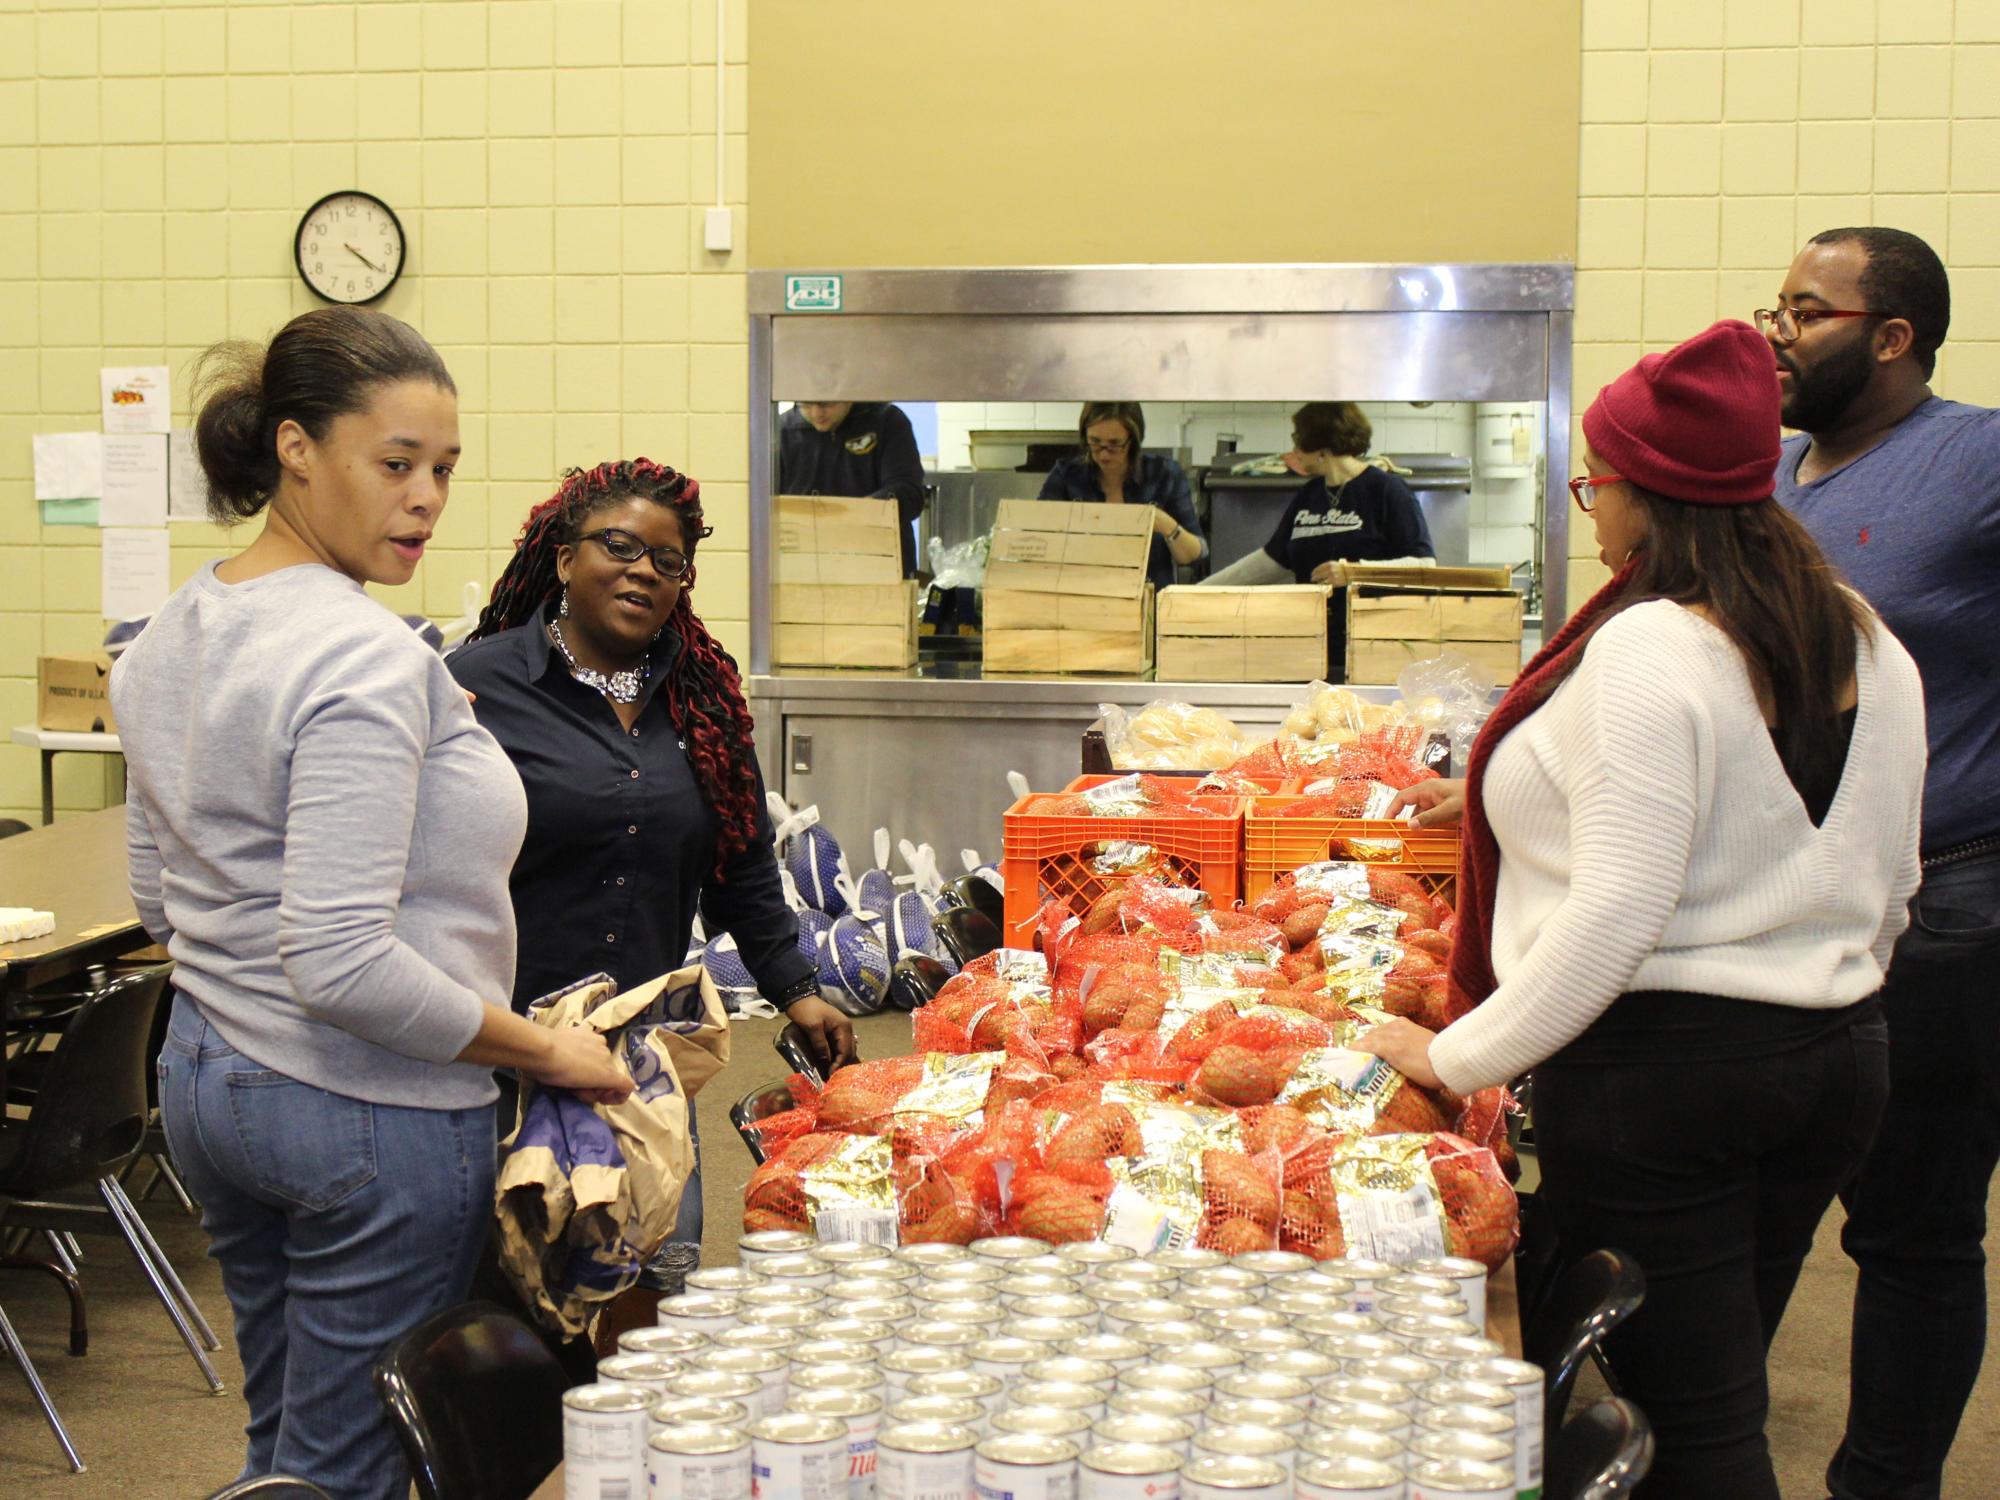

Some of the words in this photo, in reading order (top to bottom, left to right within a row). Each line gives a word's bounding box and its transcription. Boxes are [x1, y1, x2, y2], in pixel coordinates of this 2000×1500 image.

[329, 210, 339, 222] 11
[344, 204, 357, 217] 12
[314, 224, 327, 236] 10
[379, 223, 388, 236] 2
[309, 242, 319, 255] 9
[384, 242, 393, 256] 3
[314, 262, 323, 274] 8
[330, 276, 339, 289] 7
[345, 280, 356, 293] 6
[364, 276, 374, 288] 5
